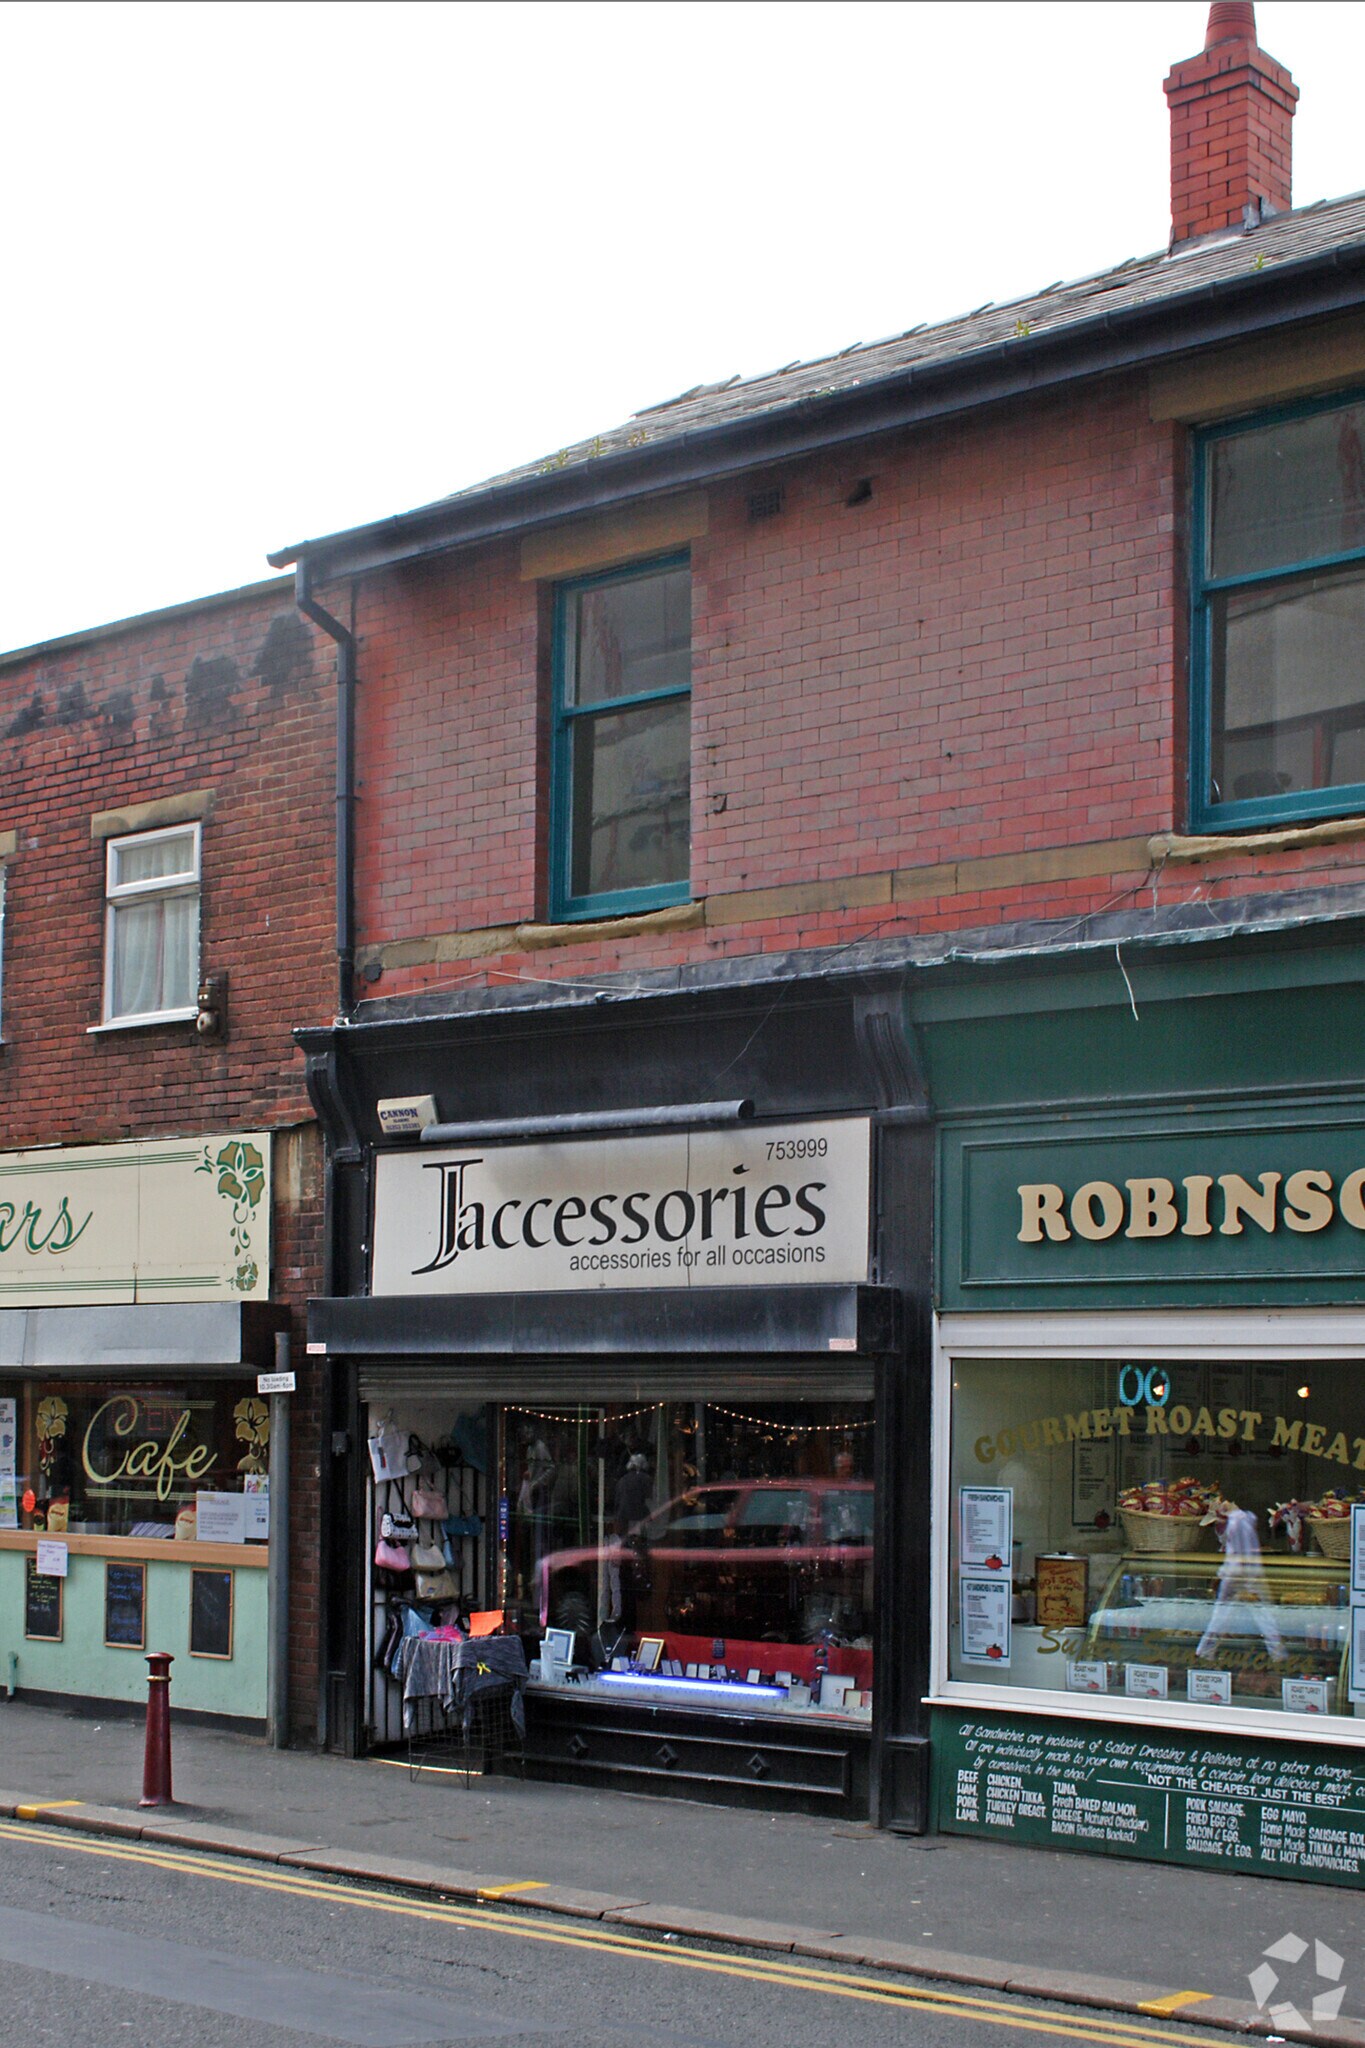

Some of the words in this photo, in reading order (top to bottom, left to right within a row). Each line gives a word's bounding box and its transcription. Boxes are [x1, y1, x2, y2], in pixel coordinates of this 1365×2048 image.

[380, 1108, 418, 1120] CANNON
[766, 1138, 828, 1161] 753999
[411, 1159, 827, 1275] Jaccessories
[569, 1248, 671, 1271] accessories
[677, 1246, 700, 1268] for
[706, 1245, 726, 1266] all
[732, 1242, 826, 1265] occasions
[974, 1406, 1135, 1464] GOURMET
[1145, 1405, 1262, 1442] ROAST
[82, 1395, 218, 1501] Cafe
[975, 1725, 1025, 1742] Sandwiches
[1027, 1734, 1044, 1744] are
[1045, 1734, 1085, 1749] inclusive
[1089, 1739, 1102, 1753] of
[1105, 1741, 1137, 1756] Salad
[1139, 1745, 1186, 1763] Dressing
[1201, 1751, 1242, 1768] Relishes
[1246, 1757, 1260, 1769] at
[1261, 1760, 1277, 1771] no
[1280, 1761, 1310, 1775] extra
[973, 1755, 986, 1770] by
[1034, 1763, 1045, 1775] in
[1046, 1764, 1061, 1777] the
[978, 1743, 994, 1753] are
[995, 1744, 1043, 1761] individually
[1045, 1751, 1071, 1763] made
[1073, 1753, 1084, 1765] to
[1082, 1756, 1107, 1768] your
[1109, 1758, 1129, 1769] own
[1209, 1769, 1246, 1782] contain
[1250, 1772, 1271, 1785] lean
[1274, 1775, 1320, 1791] delicious
[986, 1786, 1020, 1801] CHICKEN
[1176, 1777, 1198, 1790] THE
[1261, 1788, 1288, 1800] JUST
[1291, 1790, 1312, 1803] THE
[986, 1799, 1017, 1814] TURKEY
[1052, 1794, 1074, 1808] Fresh
[1075, 1797, 1101, 1812] BAKED
[1186, 1797, 1207, 1812] PORK
[1052, 1808, 1082, 1823] CHEESE
[1186, 1811, 1208, 1825] FRIED
[1210, 1814, 1226, 1828] EGG
[1261, 1806, 1279, 1821] EGG
[1051, 1820, 1075, 1835] BACON
[1186, 1824, 1213, 1839] BACON
[1260, 1821, 1282, 1835] Home
[1284, 1824, 1306, 1838] Made
[1308, 1826, 1347, 1843] SAUSAGE
[1186, 1838, 1223, 1855] SAUSAGE
[1260, 1834, 1282, 1848] Home
[1284, 1837, 1306, 1852] Made
[1308, 1840, 1333, 1856] TIKKA
[1261, 1848, 1276, 1861] ALL
[1280, 1850, 1299, 1864] HOT
